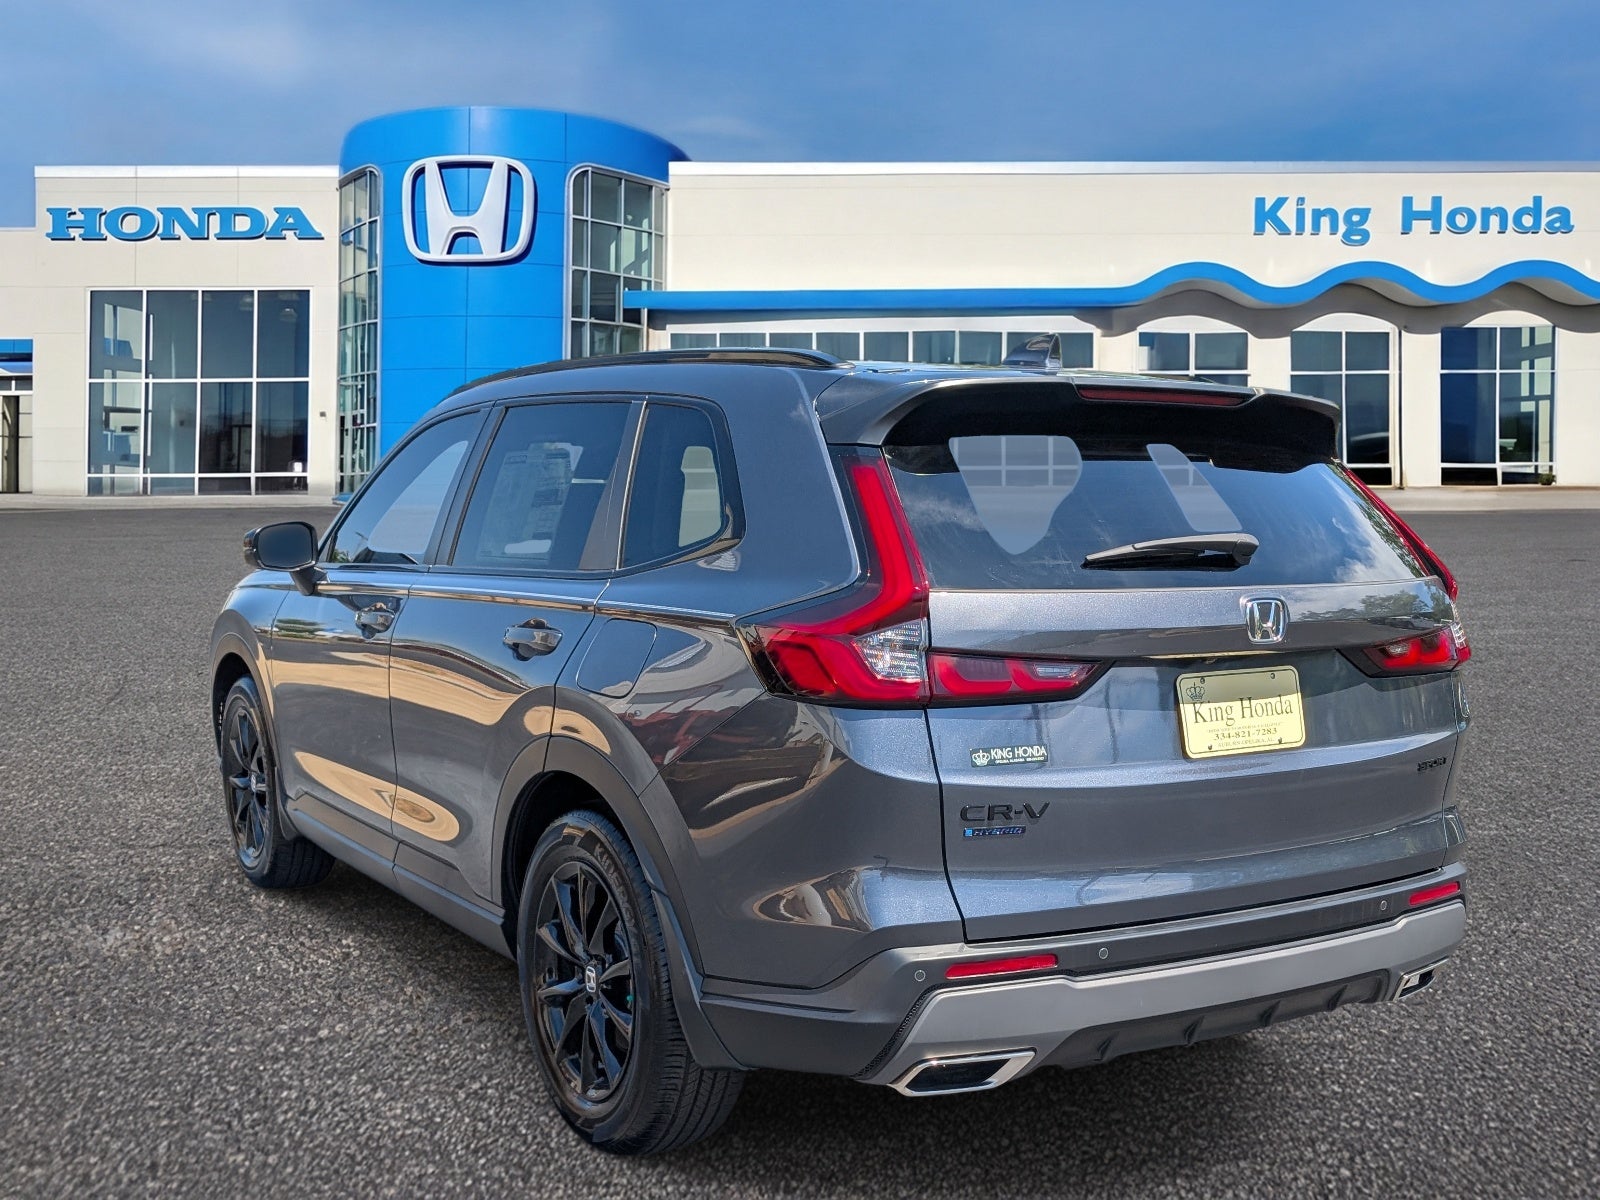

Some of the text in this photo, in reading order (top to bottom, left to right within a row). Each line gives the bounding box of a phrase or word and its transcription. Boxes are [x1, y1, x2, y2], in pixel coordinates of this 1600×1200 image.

[46, 206, 324, 241] HONDA
[1253, 195, 1575, 246] King Honda
[1193, 694, 1294, 727] King Honda
[1213, 727, 1278, 741] 334-821-7283
[990, 745, 1048, 760] KING HONDA
[960, 801, 1050, 821] CR-V
